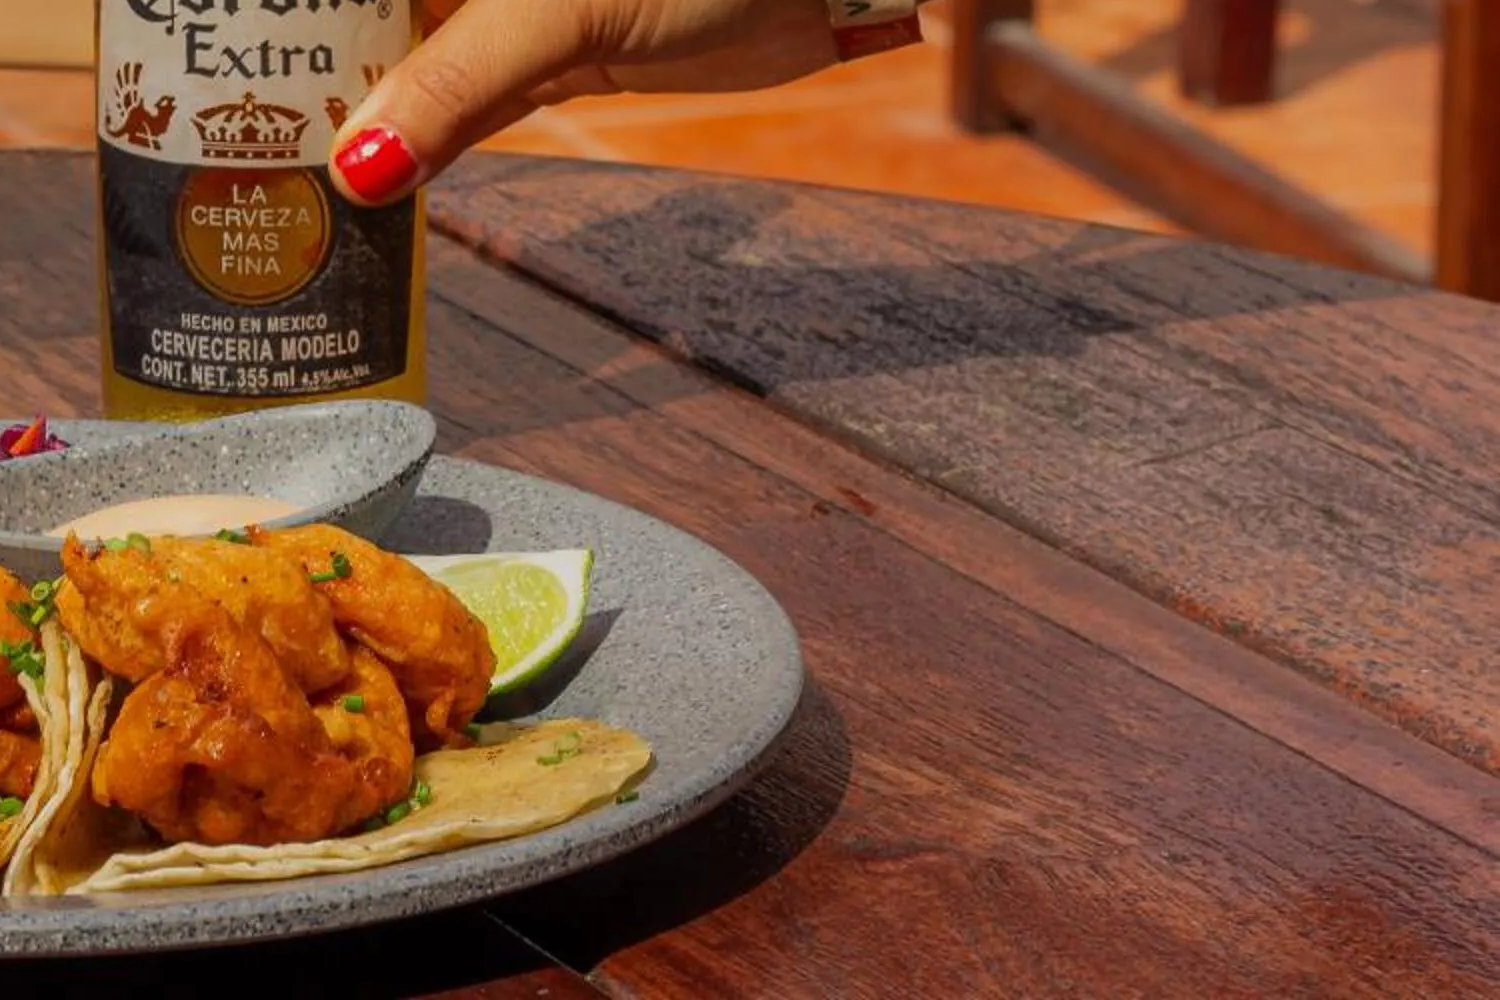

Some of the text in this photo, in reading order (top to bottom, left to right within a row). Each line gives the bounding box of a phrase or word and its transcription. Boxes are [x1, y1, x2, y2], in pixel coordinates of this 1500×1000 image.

[182, 22, 336, 78] Extra
[232, 184, 267, 204] LA
[190, 205, 312, 227] CERVEZA
[222, 232, 280, 251] MAS
[221, 256, 281, 275] FINA
[181, 313, 328, 333] HECHO EN MEXICO
[151, 328, 361, 363] CERVECERIA MODELO
[141, 353, 188, 383] CONT.
[236, 367, 269, 388] 355
[273, 365, 295, 387] ml
